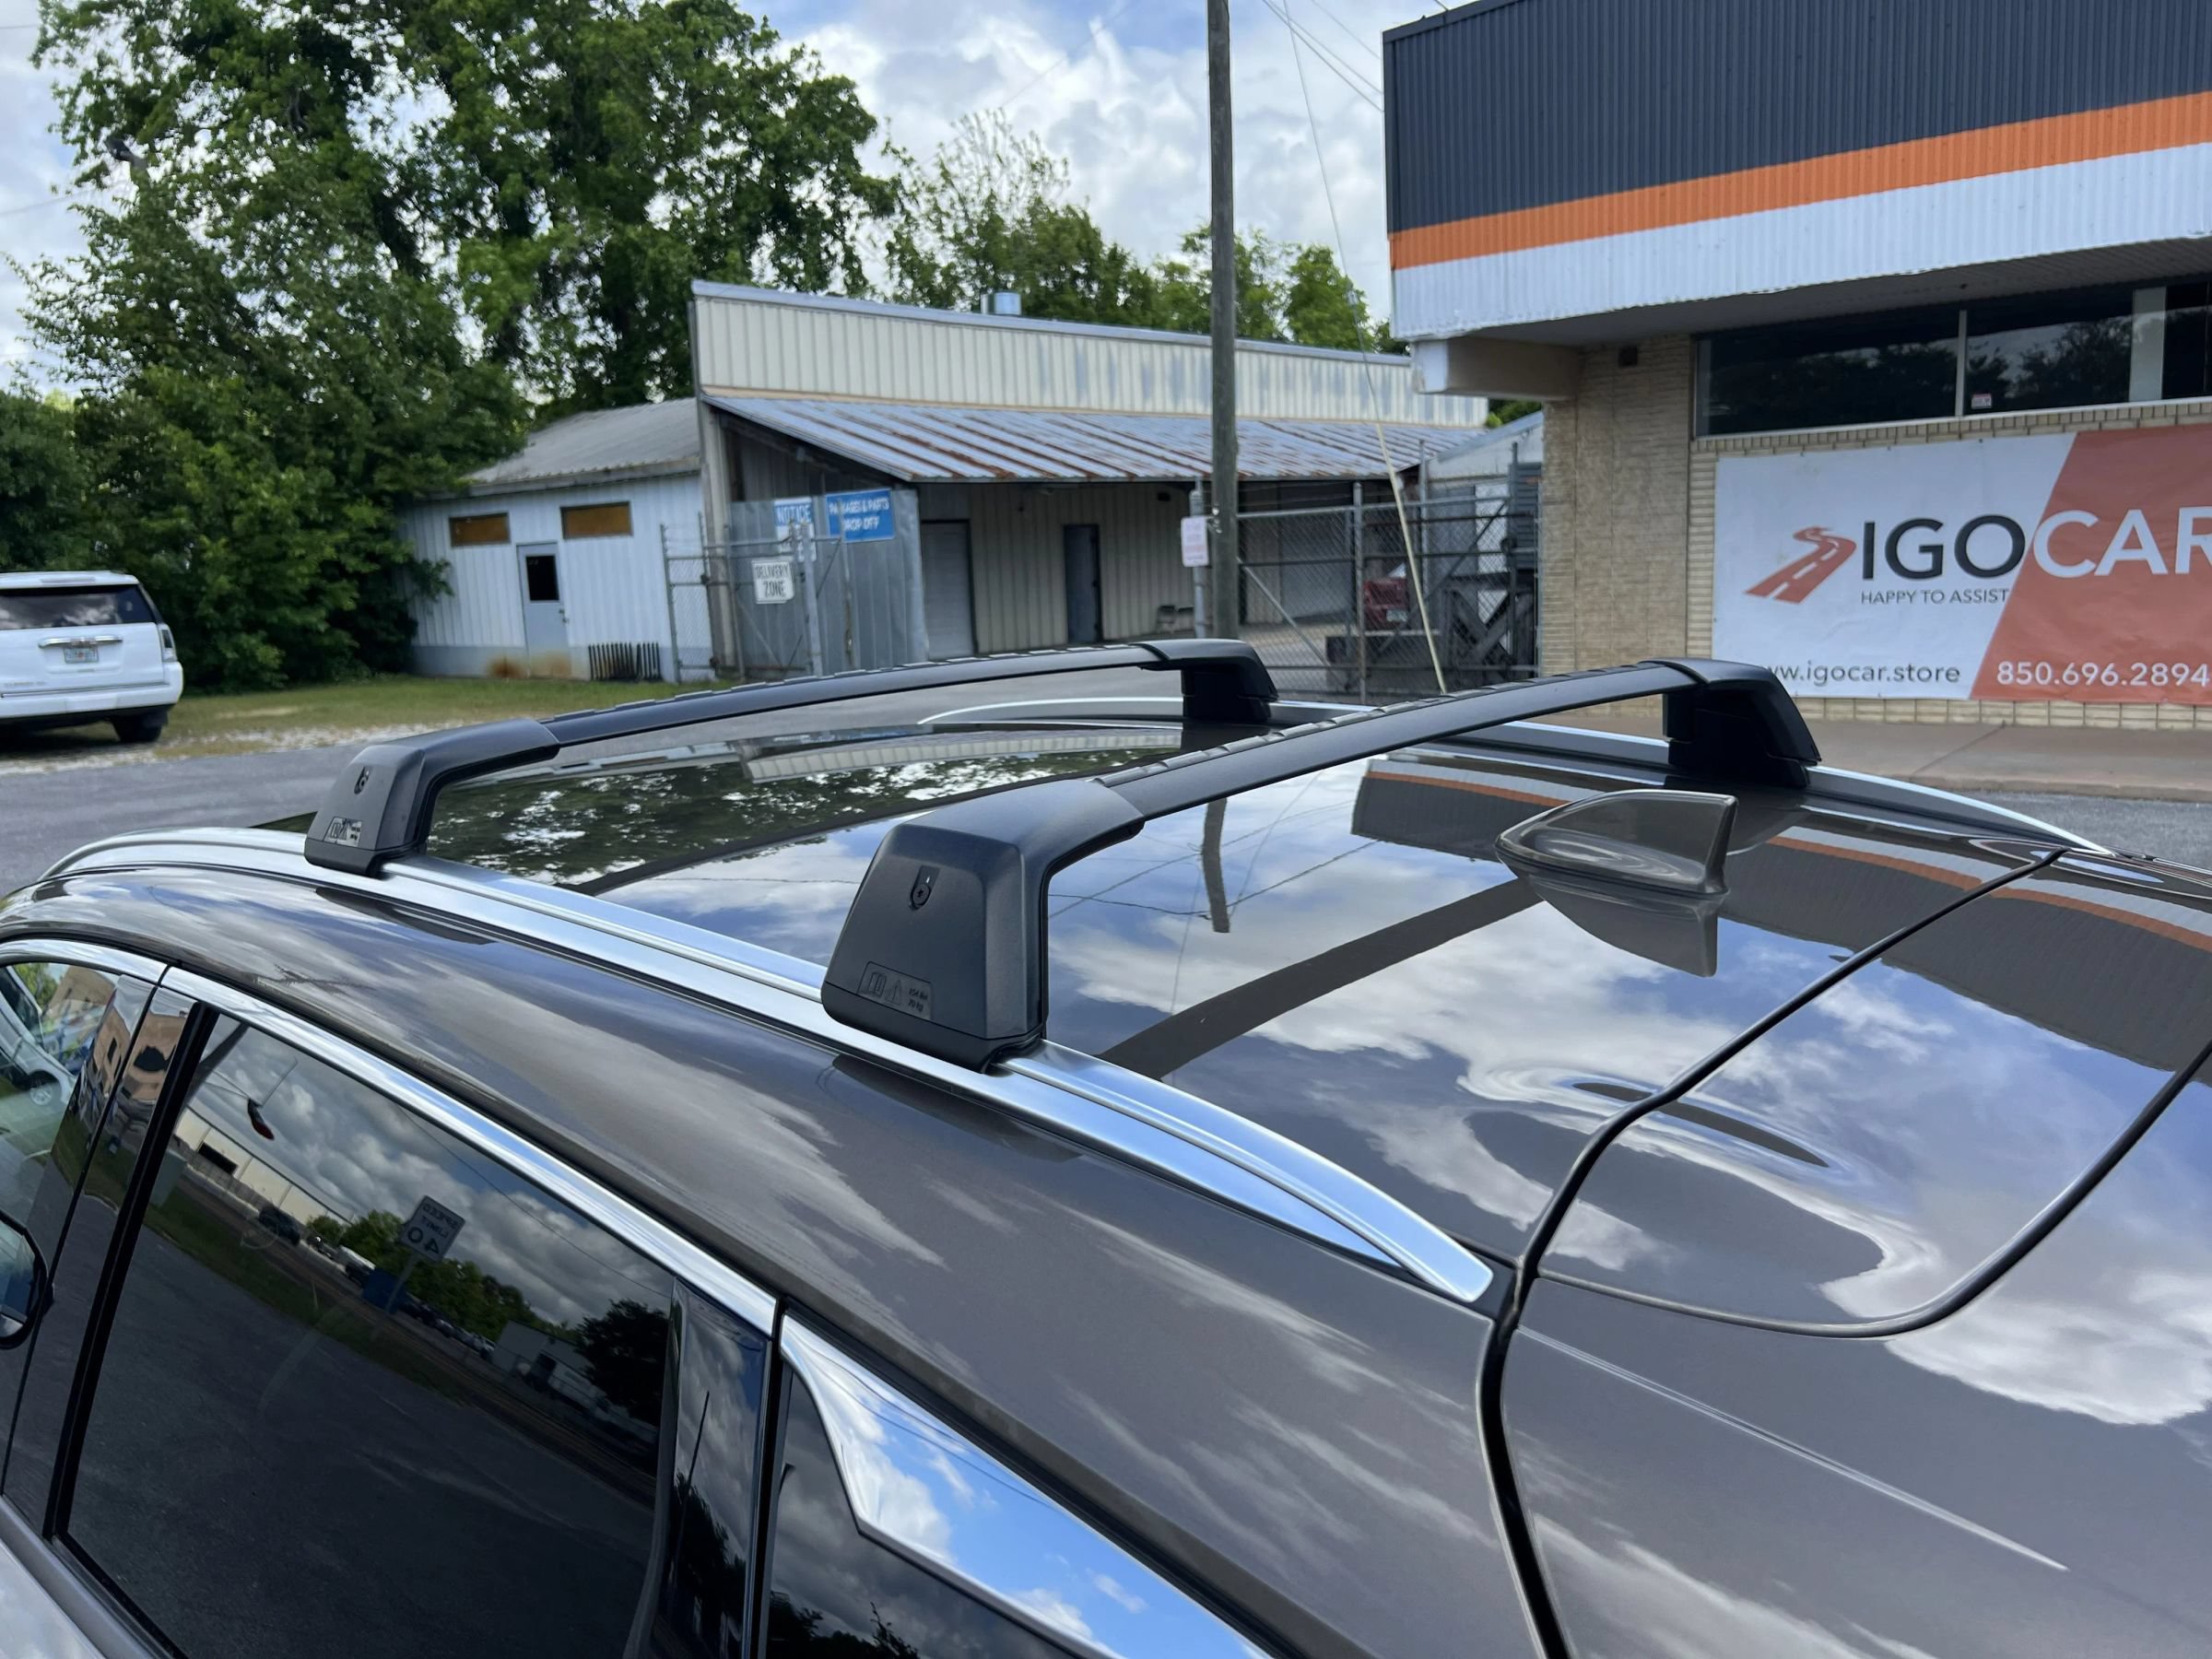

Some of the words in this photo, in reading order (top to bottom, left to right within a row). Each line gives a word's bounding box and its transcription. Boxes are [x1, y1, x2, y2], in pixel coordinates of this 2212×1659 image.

[868, 497, 890, 512] PARTS
[777, 504, 812, 524] NOTICE
[863, 516, 880, 530] OFF
[1861, 506, 2212, 581] IGOCAR
[756, 562, 789, 579] DELIVERY
[763, 581, 786, 597] ZONE
[1861, 590, 1917, 605] HAPPY
[1921, 589, 1945, 605] TO
[1949, 588, 2009, 605] ASSIST
[1996, 661, 2210, 687] 850.696.2894
